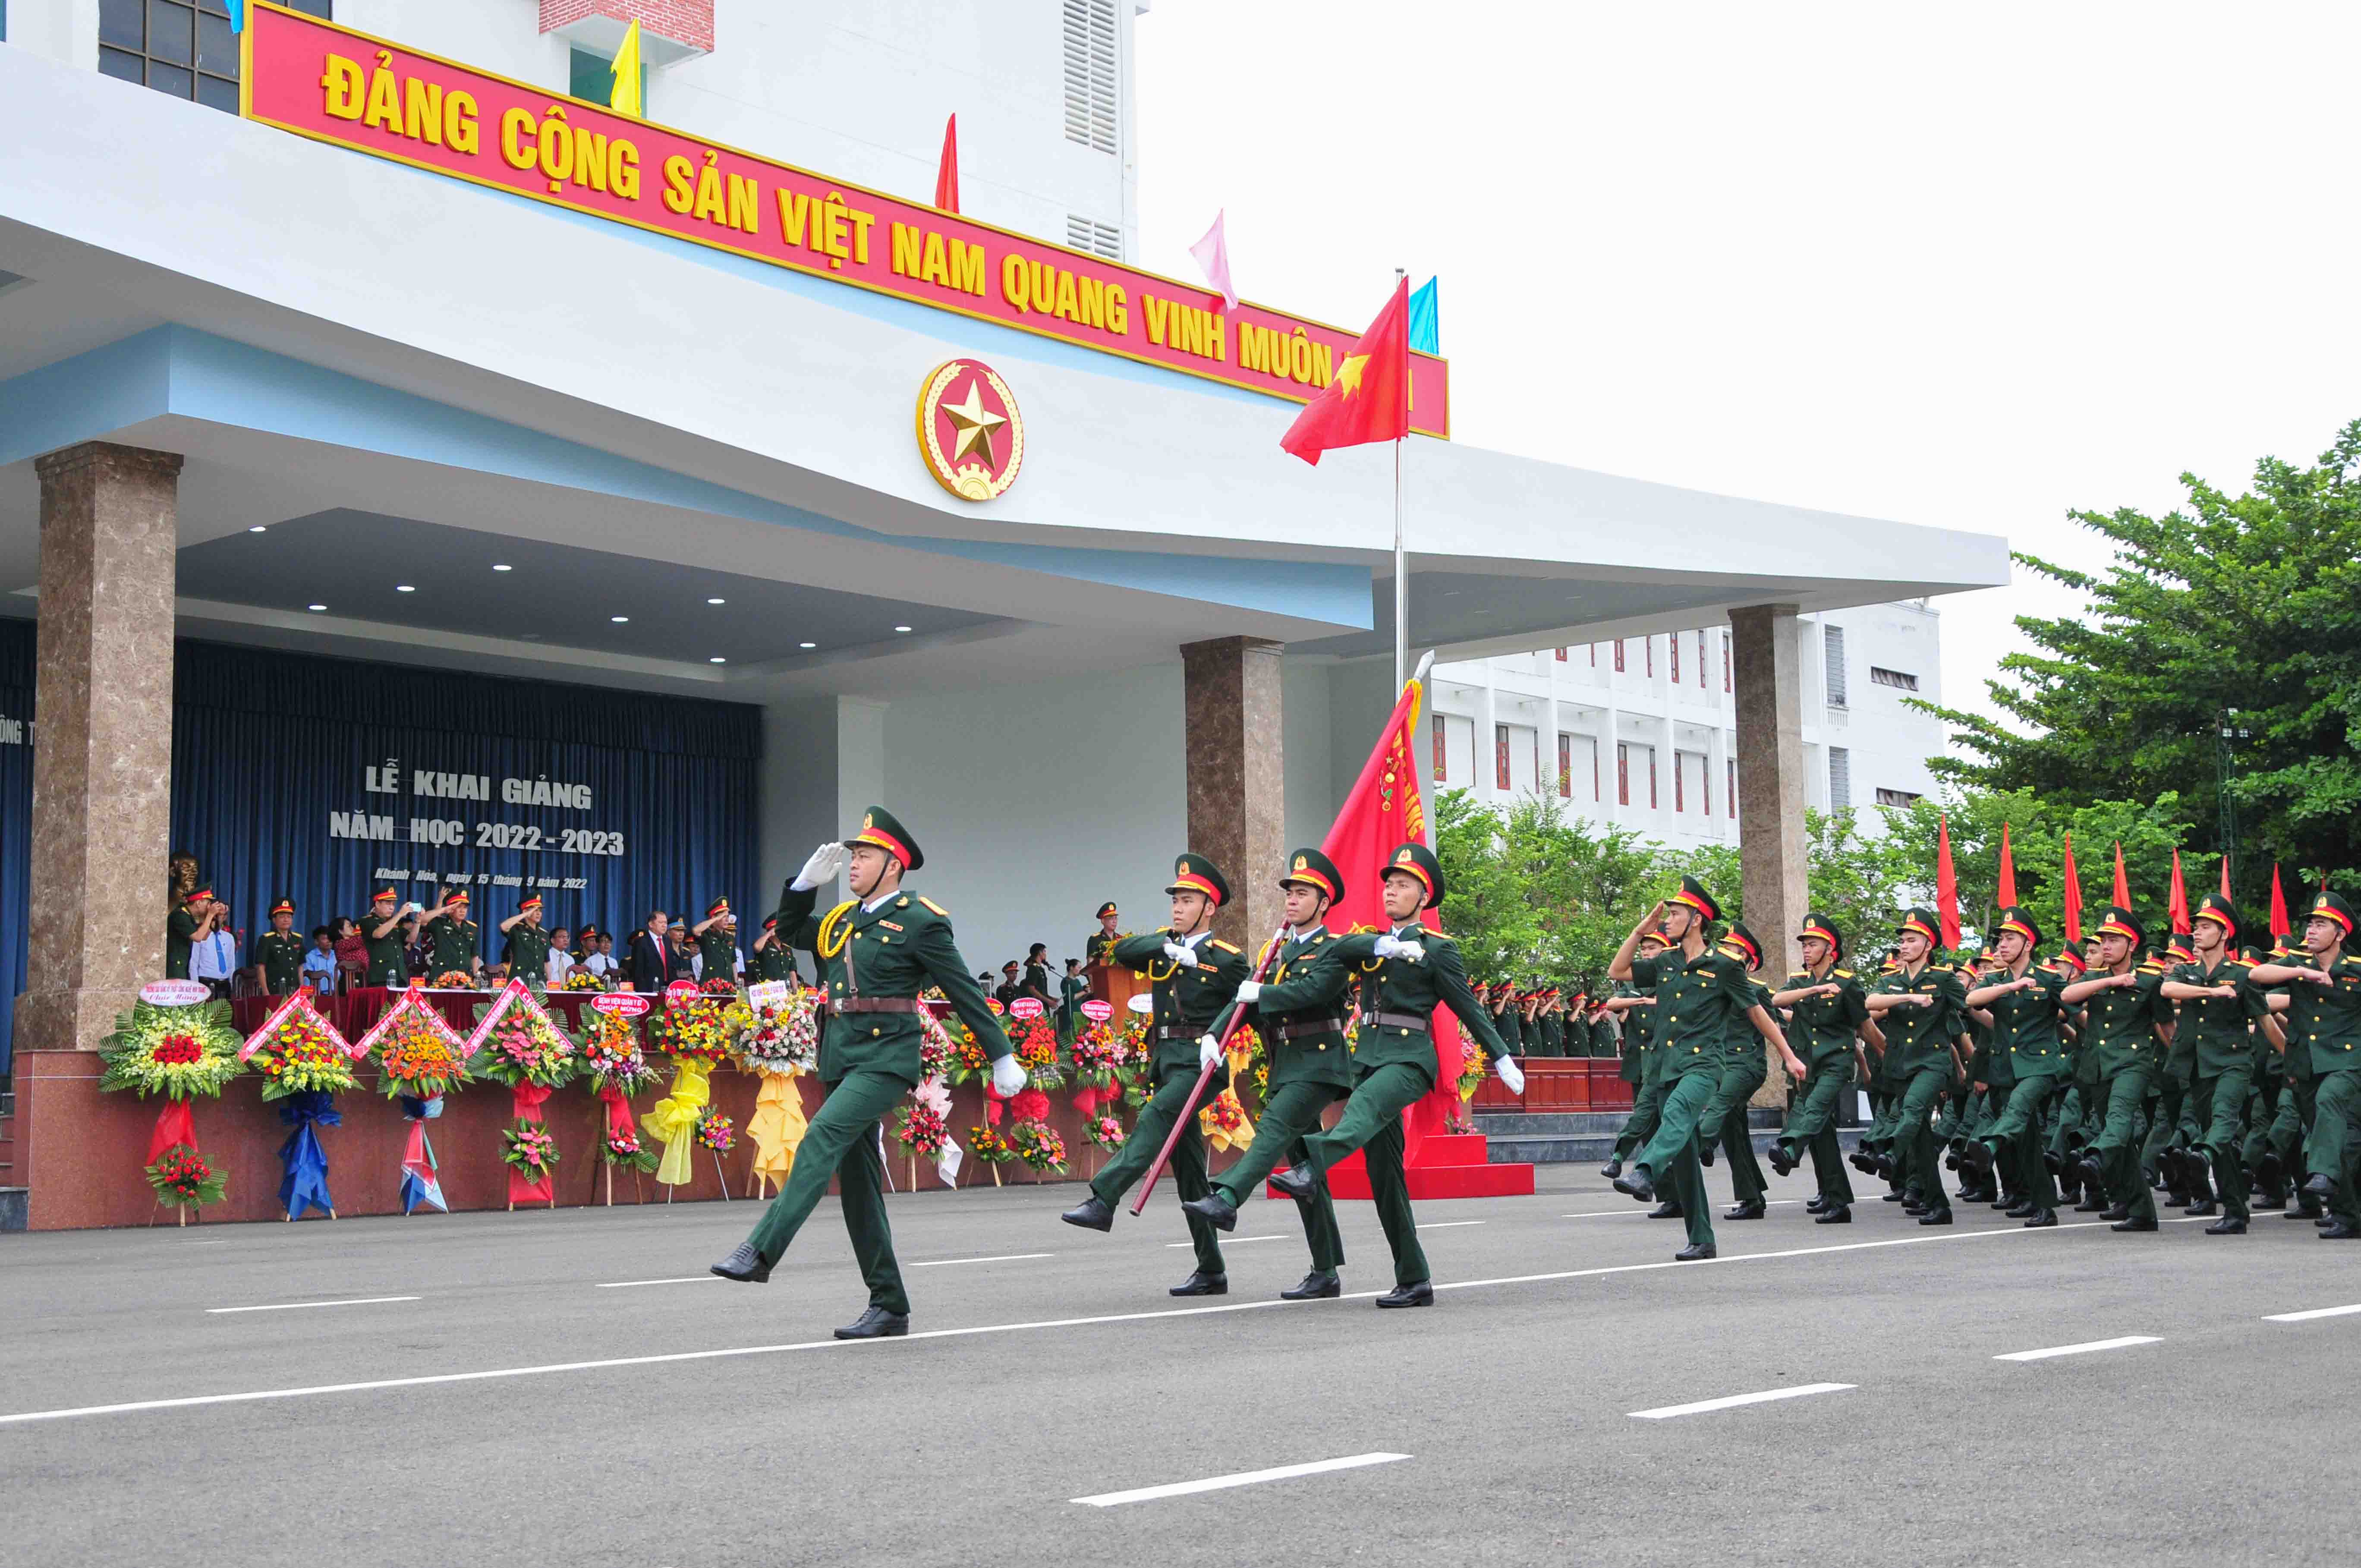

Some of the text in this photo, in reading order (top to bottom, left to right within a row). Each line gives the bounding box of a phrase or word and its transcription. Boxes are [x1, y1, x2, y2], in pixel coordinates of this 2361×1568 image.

[321, 50, 478, 155] ĐẢNG
[502, 105, 639, 200] CỘNG
[664, 150, 758, 233] SẢN
[777, 191, 875, 268] VIỆT
[891, 221, 985, 296] NAM
[1002, 254, 1127, 335] QUANG
[1143, 294, 1225, 361] VINH
[1240, 327, 1332, 388] MUÔN
[366, 758, 592, 809] LỄ KHAI GIẢNG
[331, 809, 393, 841] NĂM
[410, 818, 464, 848] HỌC
[375, 868, 410, 881] Khánh
[478, 874, 490, 885] 15
[493, 874, 523, 887] tháng
[526, 877, 535, 887] 9
[563, 878, 587, 889] 2022
